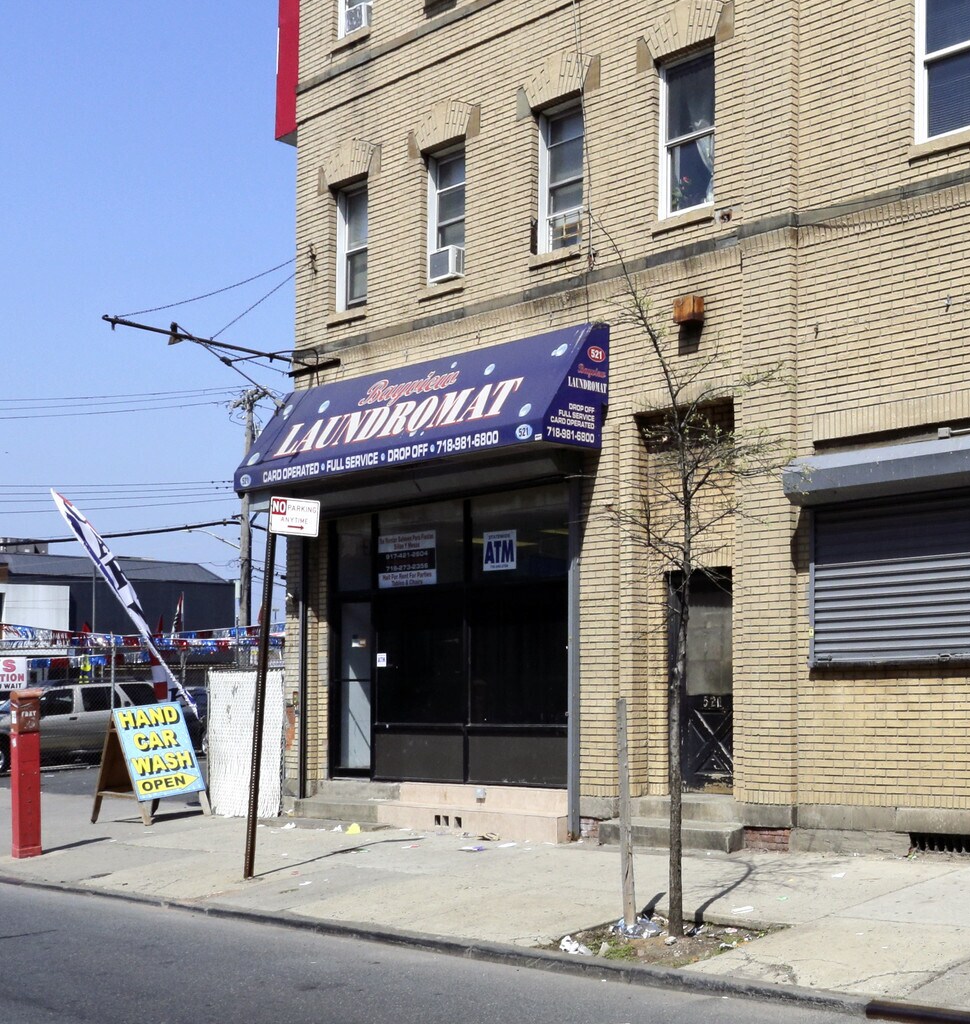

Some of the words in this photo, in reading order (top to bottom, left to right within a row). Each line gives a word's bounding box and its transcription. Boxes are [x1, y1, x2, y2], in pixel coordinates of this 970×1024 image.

[590, 349, 603, 360] 521
[358, 371, 460, 406] Bayview
[568, 376, 608, 394] LAUNDROMAT
[558, 409, 572, 419] FULL
[572, 411, 595, 422] SERVICE
[569, 403, 584, 413] DROP
[584, 405, 595, 414] OFF
[272, 377, 524, 458] LAUNDROMAT
[550, 416, 566, 424] CARD
[566, 417, 595, 430] OPERATED
[518, 427, 529, 437] 521
[546, 426, 595, 443] 718-981-6800
[262, 468, 281, 483] CARD
[282, 462, 320, 480] OPERATED
[326, 458, 345, 472] FULL
[345, 451, 379, 469] SERVICE
[387, 445, 411, 462] DROP
[412, 443, 429, 459] OFF
[437, 430, 499, 454] 718-981-6800
[272, 500, 286, 514] NO
[287, 504, 317, 514] PARKING
[280, 516, 308, 524] ANYTIME
[484, 539, 515, 564] ATM
[118, 706, 180, 730] HAND
[133, 729, 181, 752] CAR
[131, 750, 195, 776] WASH
[142, 775, 186, 791] OPEN
